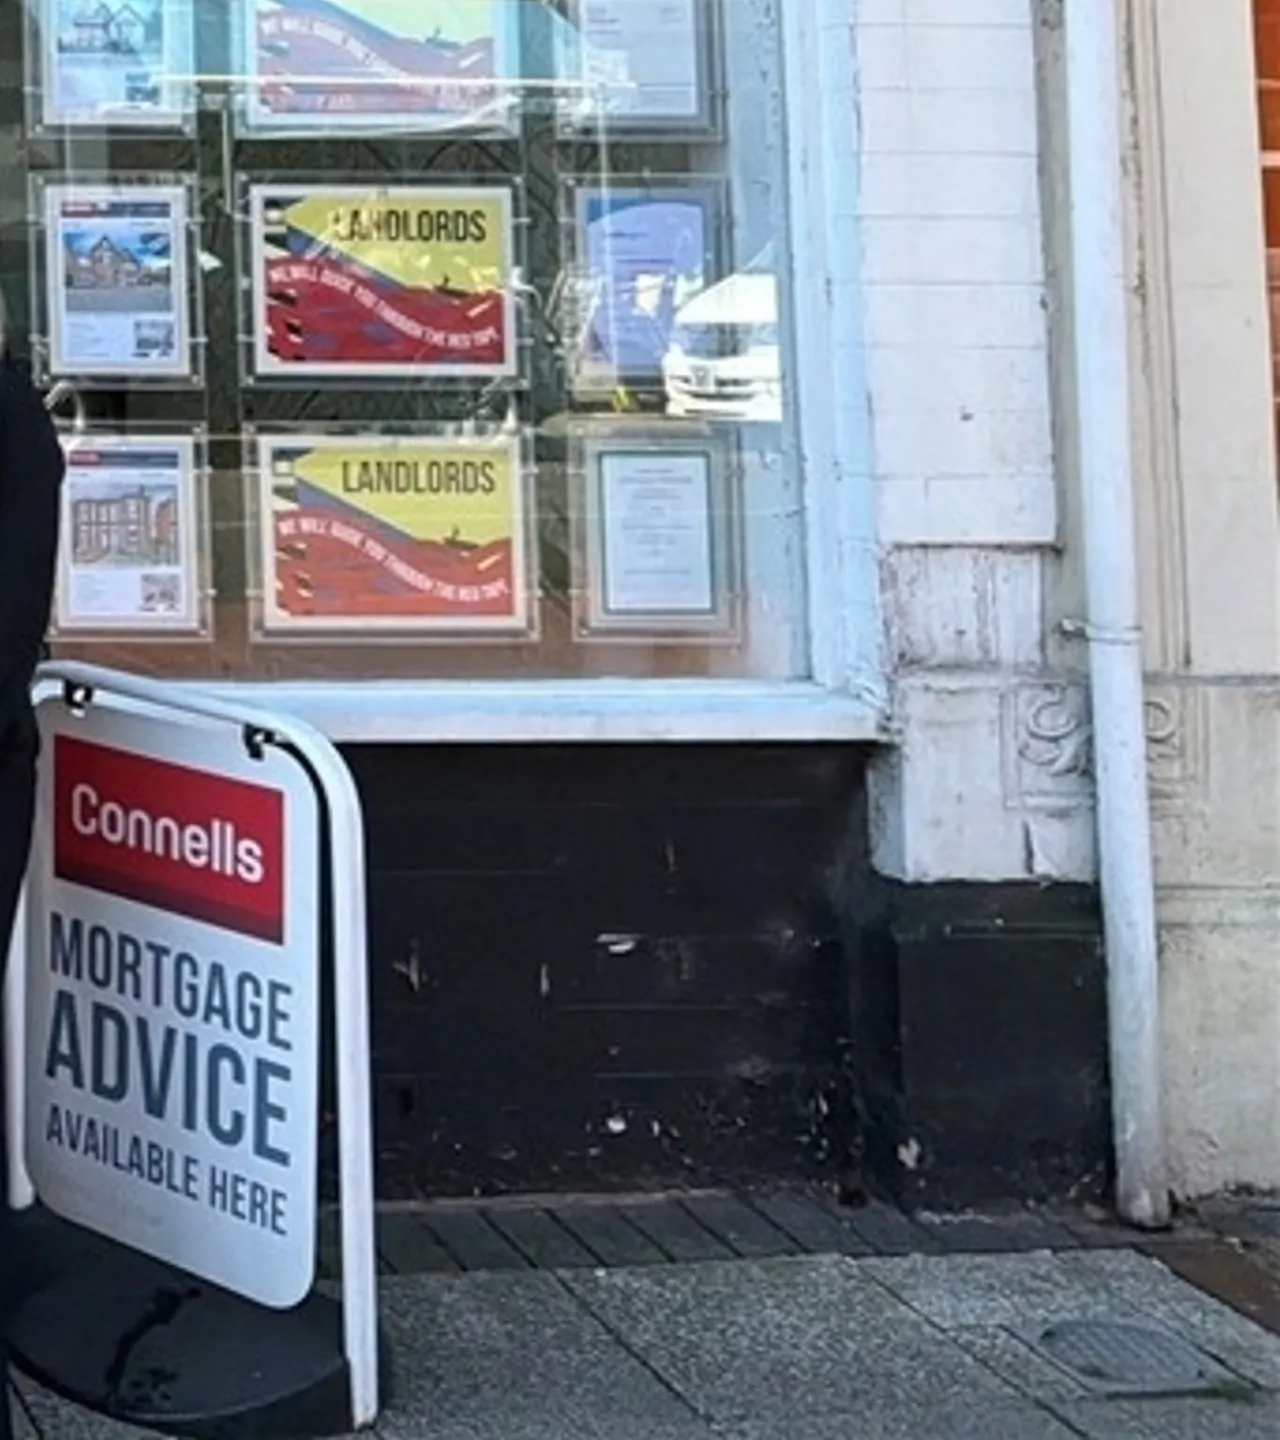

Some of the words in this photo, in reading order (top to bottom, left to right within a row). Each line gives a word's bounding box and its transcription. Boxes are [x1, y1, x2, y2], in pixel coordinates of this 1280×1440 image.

[342, 460, 496, 494] LANDLORDS
[72, 783, 264, 884] Connells
[50, 910, 293, 1052] MORTGAGE
[45, 988, 292, 1167] ADVICE
[46, 1103, 199, 1201] AVAILABLE
[209, 1164, 288, 1237] HERE
